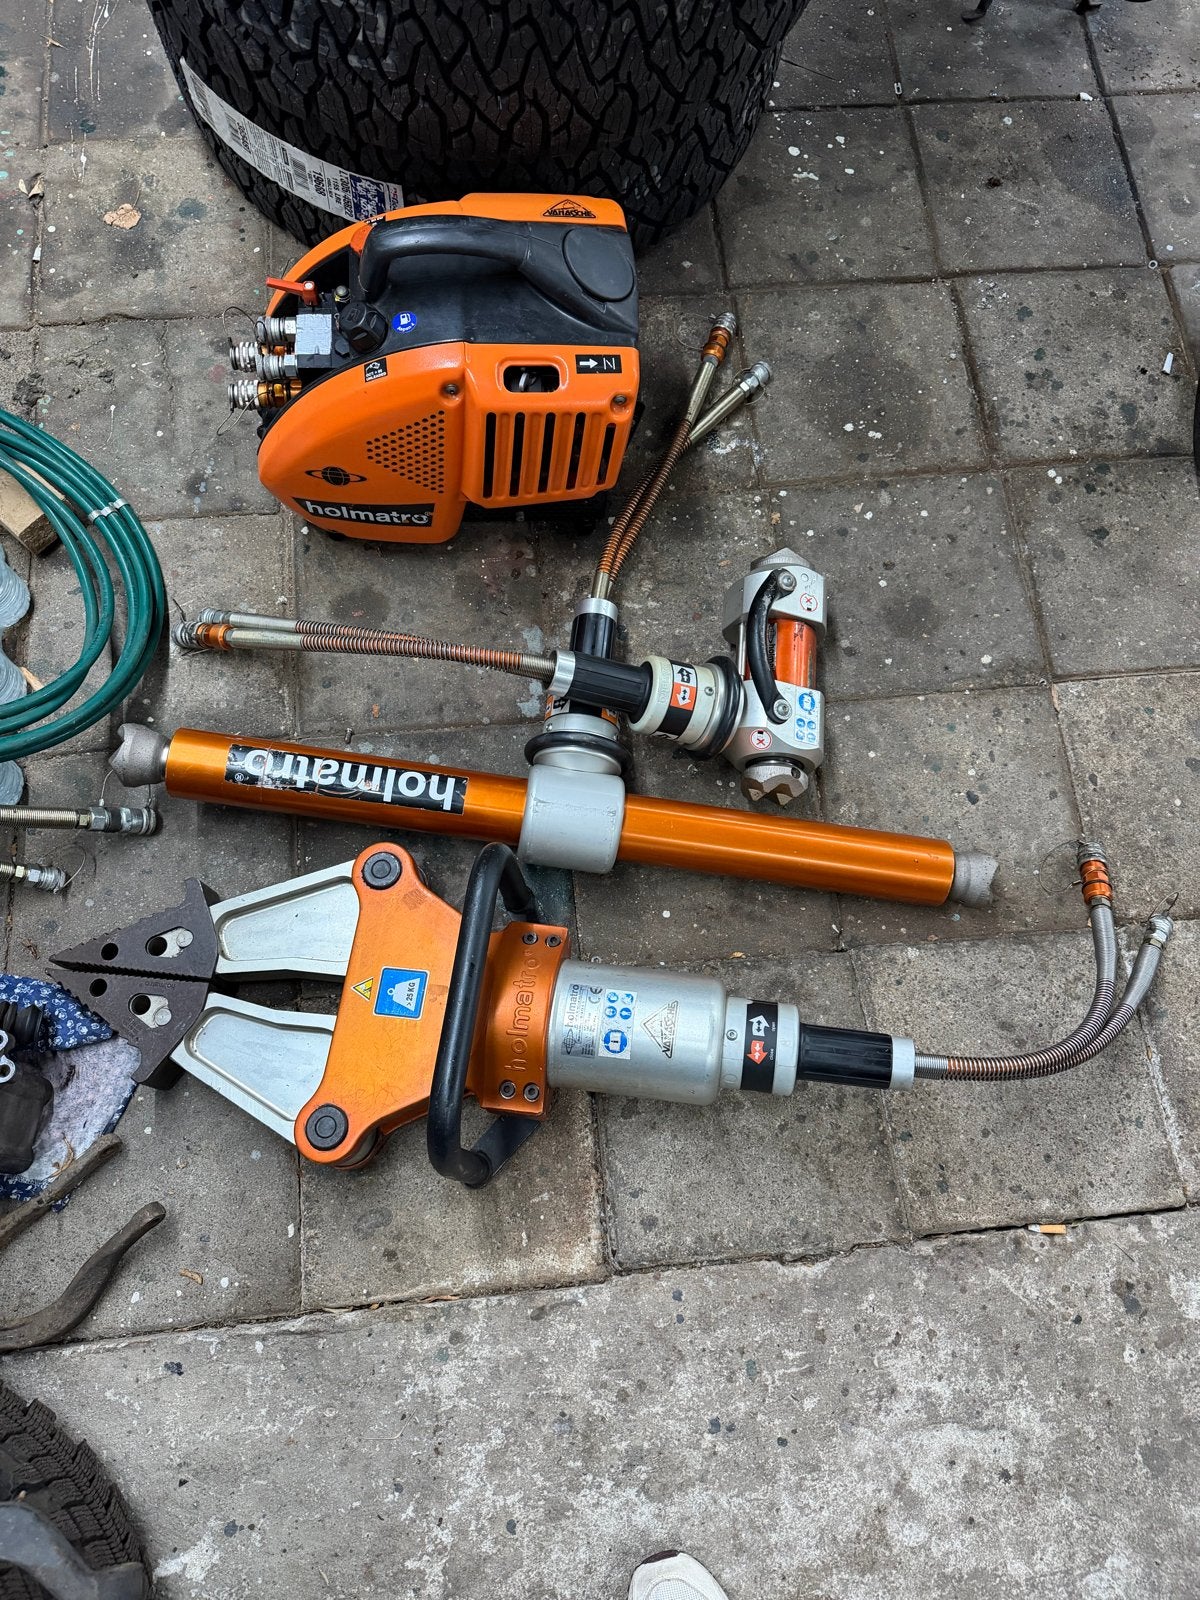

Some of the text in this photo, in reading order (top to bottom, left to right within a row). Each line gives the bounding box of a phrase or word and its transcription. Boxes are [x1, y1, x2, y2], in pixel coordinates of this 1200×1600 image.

[305, 500, 428, 524] holmatro
[244, 749, 456, 811] holmatro
[504, 957, 541, 1072] holmatro
[565, 984, 580, 1028] holmatro
